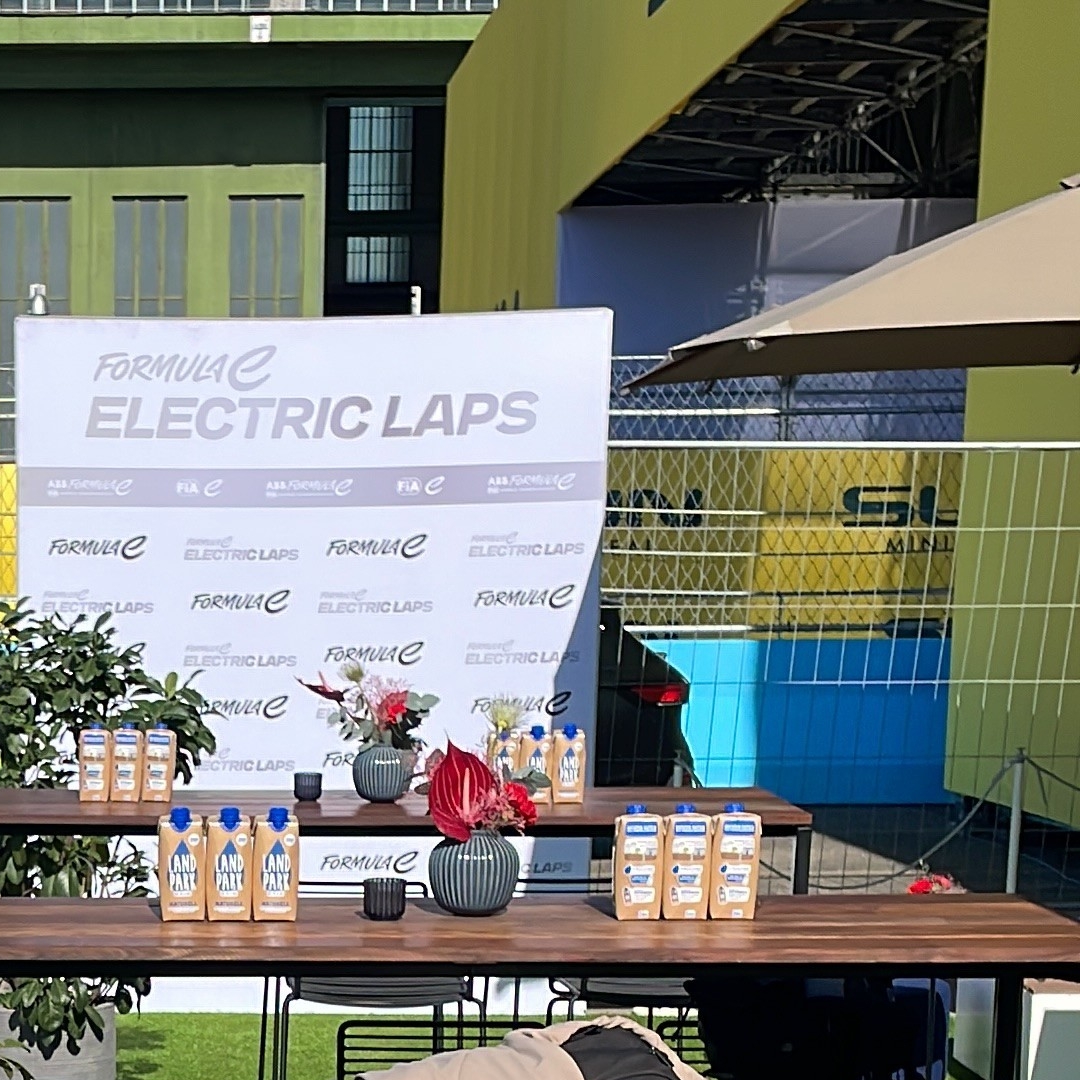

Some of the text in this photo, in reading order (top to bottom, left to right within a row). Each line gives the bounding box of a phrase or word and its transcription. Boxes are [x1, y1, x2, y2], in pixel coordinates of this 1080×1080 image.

[85, 390, 540, 440] ELECTRIC LAPS
[184, 549, 299, 561] ELECTRIC LAPS
[468, 542, 585, 558] ELECTRIC LAPS
[41, 601, 154, 614] ELECTRIC LAPS
[318, 601, 433, 614] ELECTRIC LAPS
[183, 656, 298, 668] ELECTRIC LAPS
[465, 652, 540, 665] ELECTRIC
[256, 760, 296, 772] LAPS
[168, 853, 197, 873] LAND
[215, 853, 244, 873] LAND
[262, 853, 292, 873] LAND
[169, 872, 197, 891] PARK
[216, 872, 243, 891] PARK
[263, 872, 290, 891] PARK
